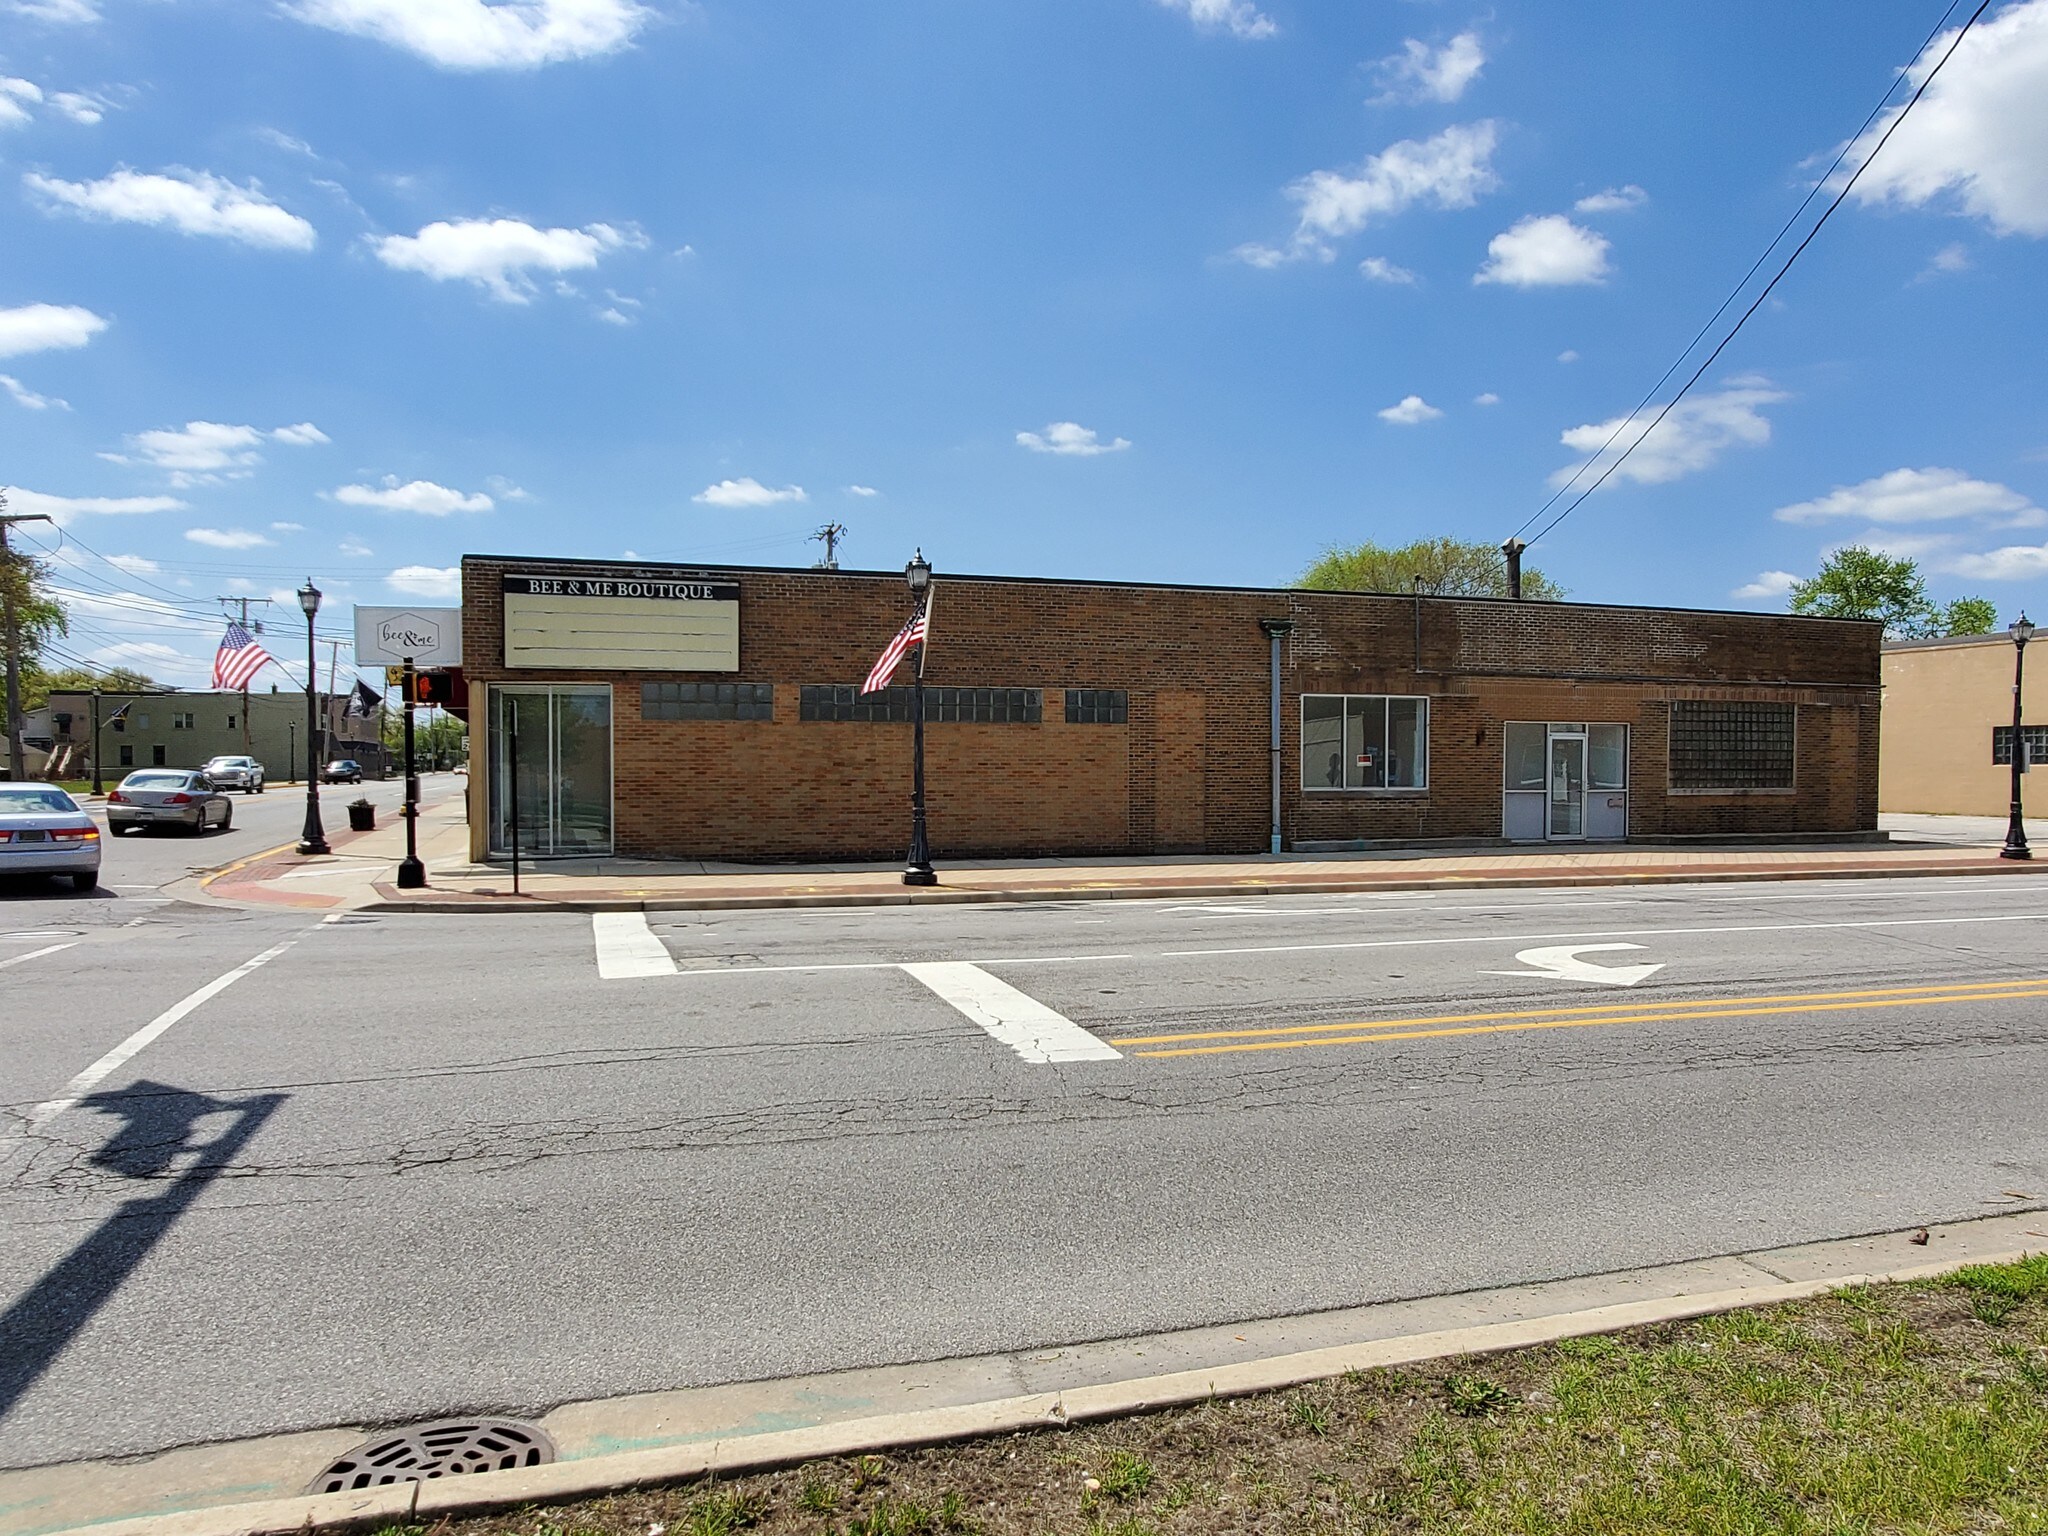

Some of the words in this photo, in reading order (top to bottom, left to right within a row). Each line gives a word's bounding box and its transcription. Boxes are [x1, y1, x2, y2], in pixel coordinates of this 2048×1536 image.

[529, 580, 563, 594] BEE
[567, 580, 581, 594] &
[585, 582, 613, 596] ME
[617, 583, 714, 600] BOUTIQUE
